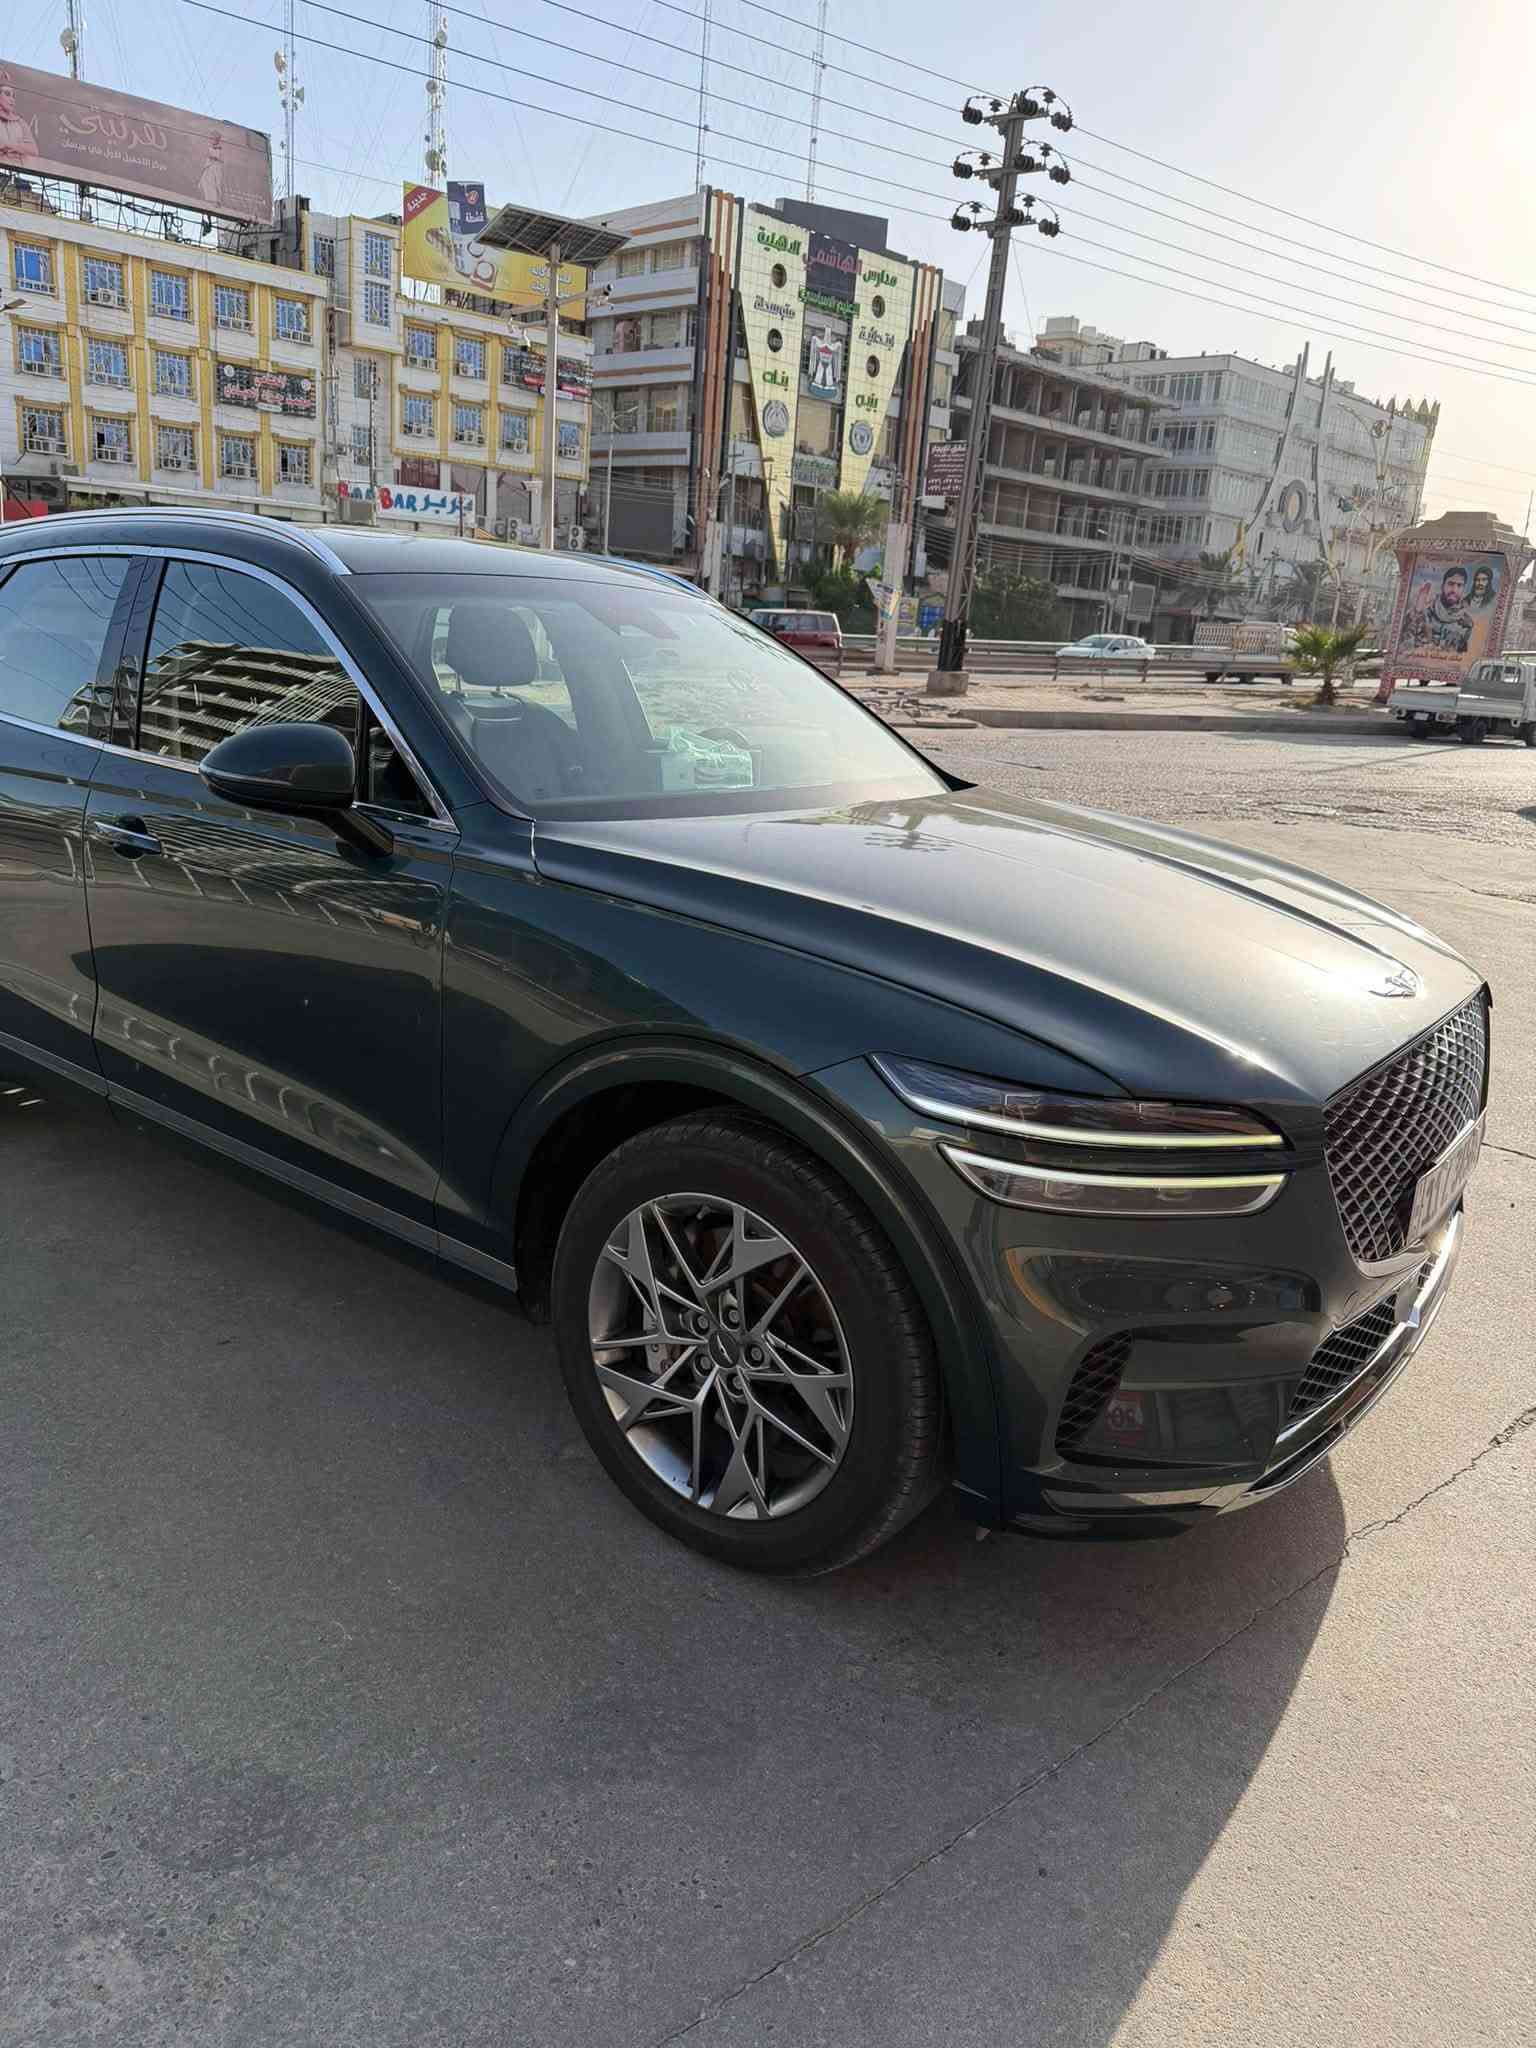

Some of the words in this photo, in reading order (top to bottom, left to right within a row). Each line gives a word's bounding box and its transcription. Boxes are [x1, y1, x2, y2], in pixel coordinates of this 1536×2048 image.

[802, 245, 864, 276] الهاشمي
[863, 269, 898, 289] مدارس
[378, 485, 418, 512] BAR
